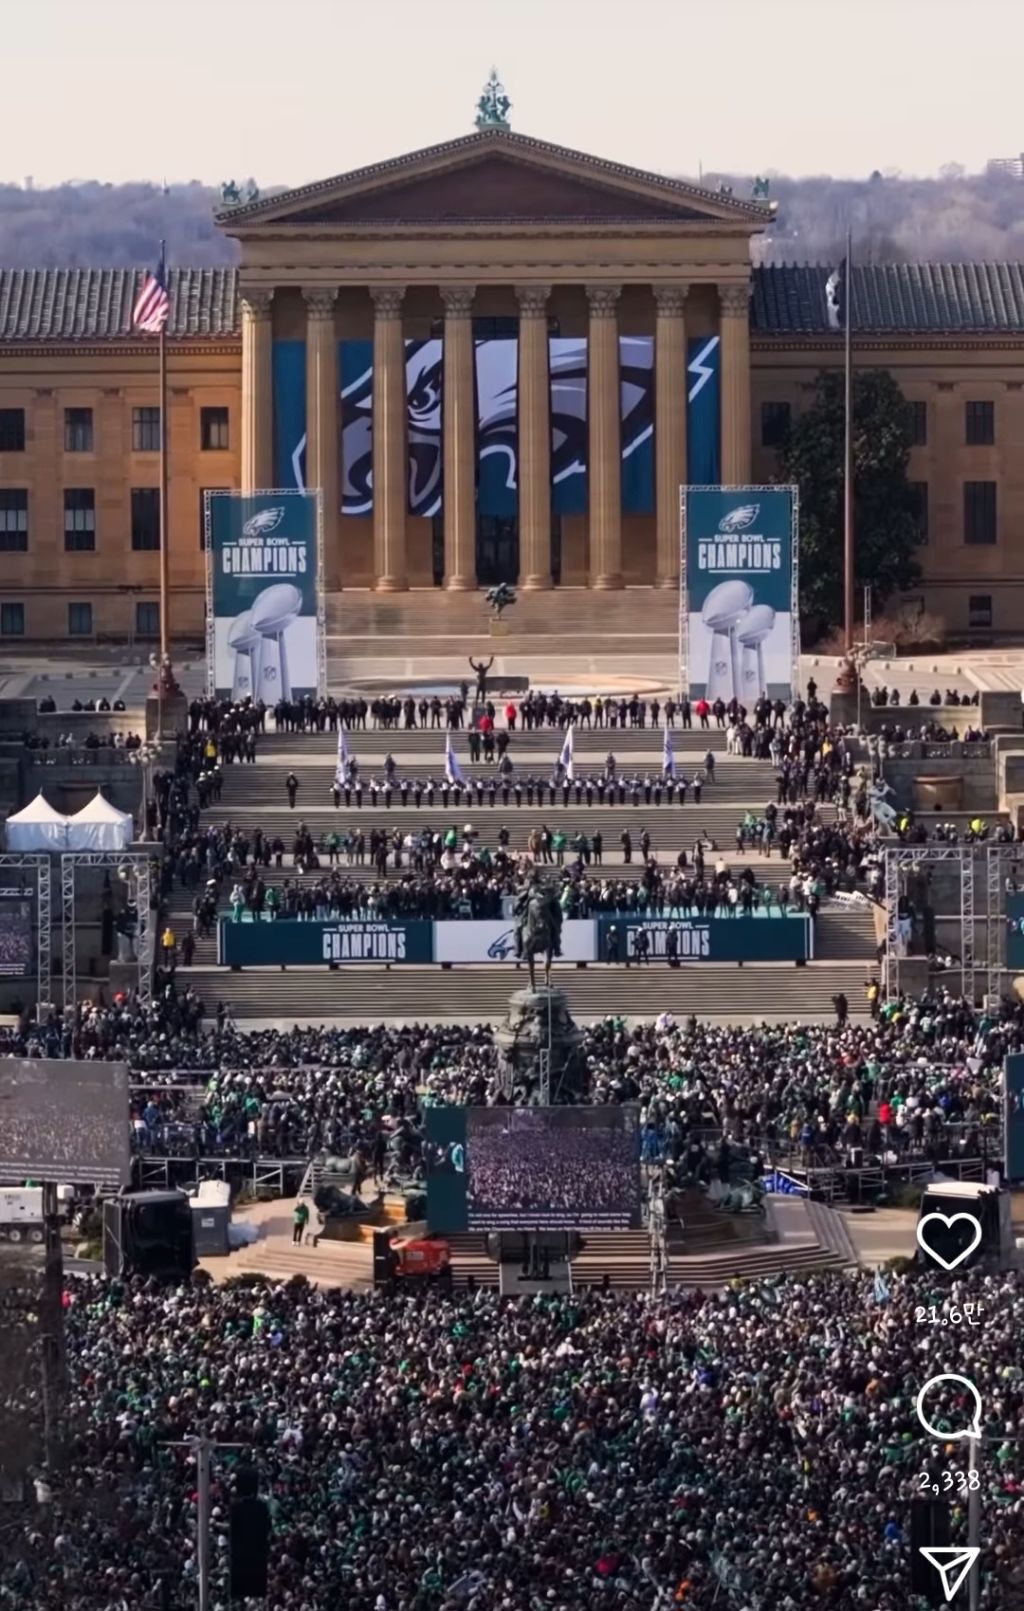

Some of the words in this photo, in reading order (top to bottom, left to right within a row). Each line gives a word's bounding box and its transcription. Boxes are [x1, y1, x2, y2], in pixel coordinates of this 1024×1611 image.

[238, 538, 264, 546] SUPER
[266, 537, 290, 546] BOWL
[714, 534, 739, 543] SUPER
[741, 534, 765, 543] BOWL
[222, 546, 307, 573] CHAMPIONS
[698, 543, 781, 569] CHAMPIONS
[338, 924, 364, 932] SUPER
[366, 924, 390, 932] BOWL
[642, 921, 668, 930] SUPER
[322, 933, 406, 959] CHAMPIONS
[626, 930, 710, 956] CAMIONS
